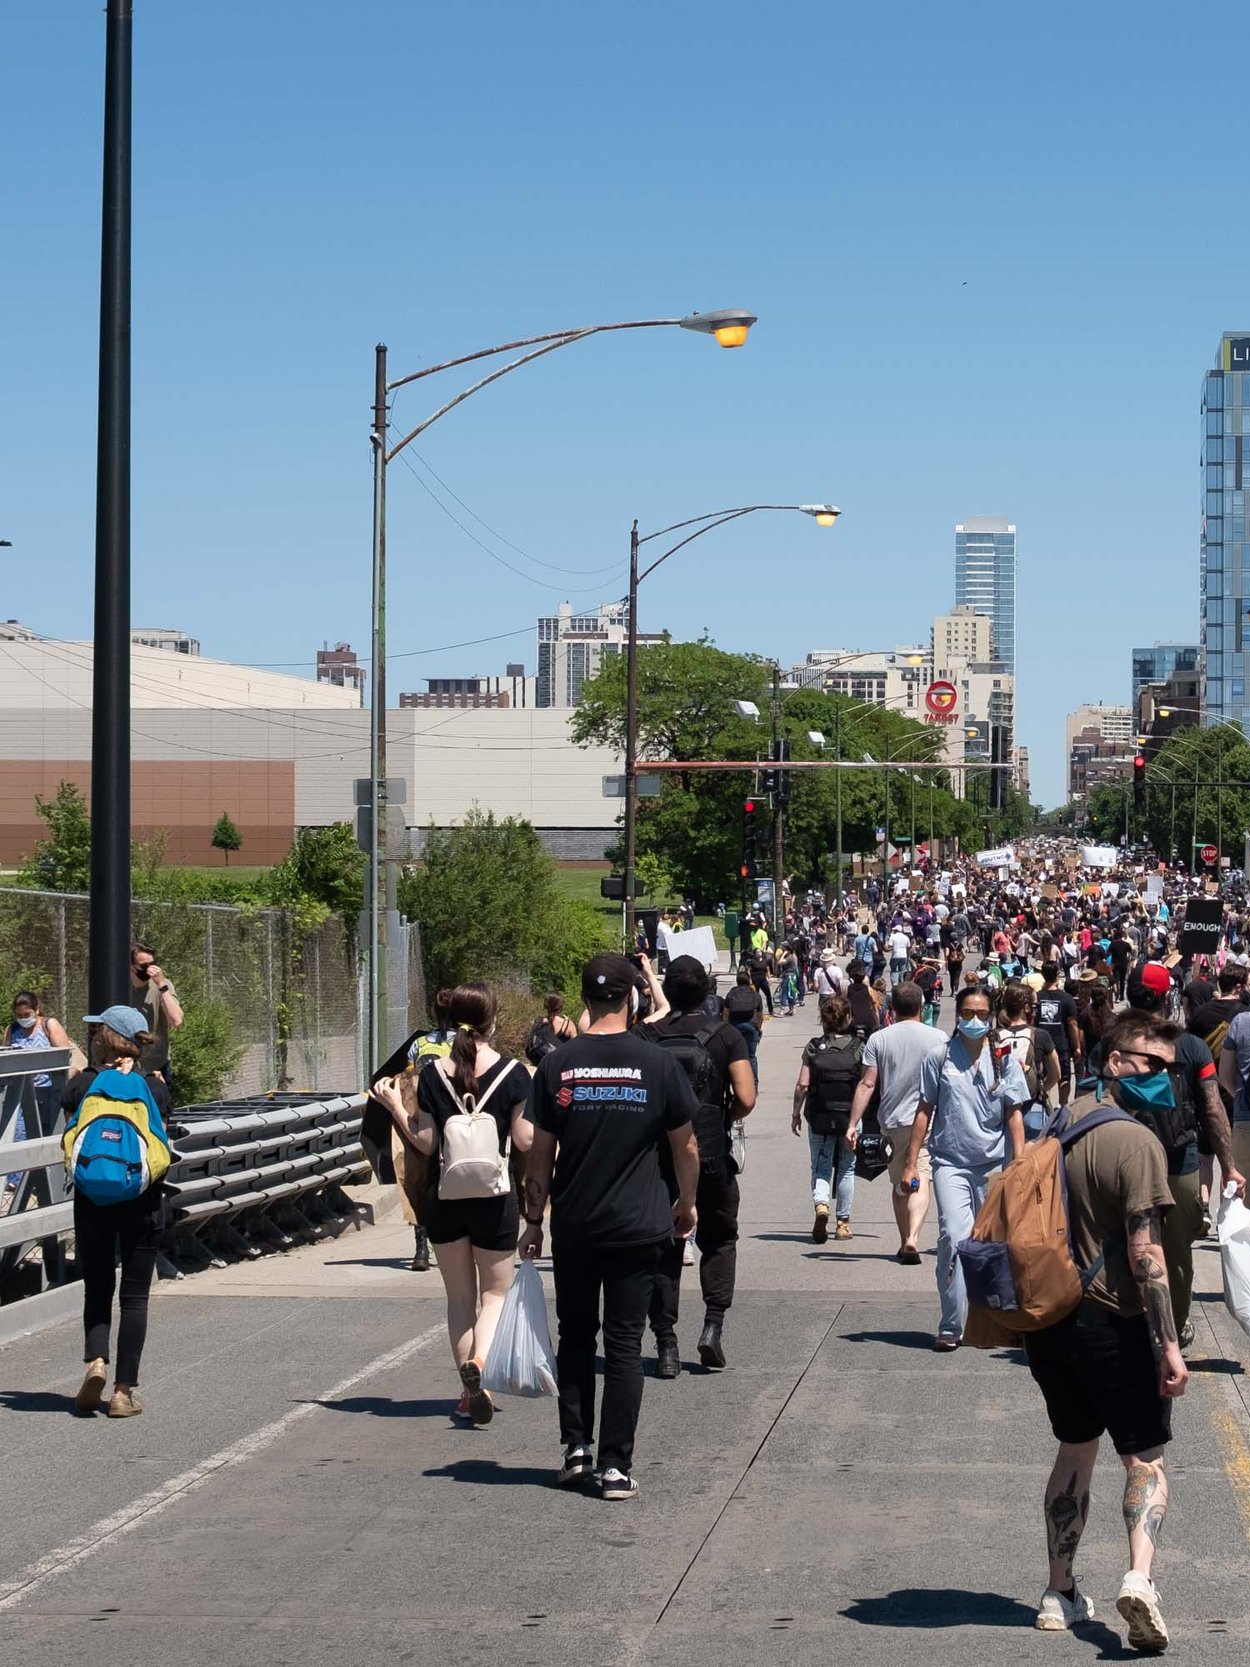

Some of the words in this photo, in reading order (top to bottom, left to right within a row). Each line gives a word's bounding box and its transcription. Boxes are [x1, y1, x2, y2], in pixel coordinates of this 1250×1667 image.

[1184, 921, 1221, 932] ENOUGH
[574, 1067, 642, 1080] YOSHIMURA
[573, 1086, 647, 1103] SUZUKI
